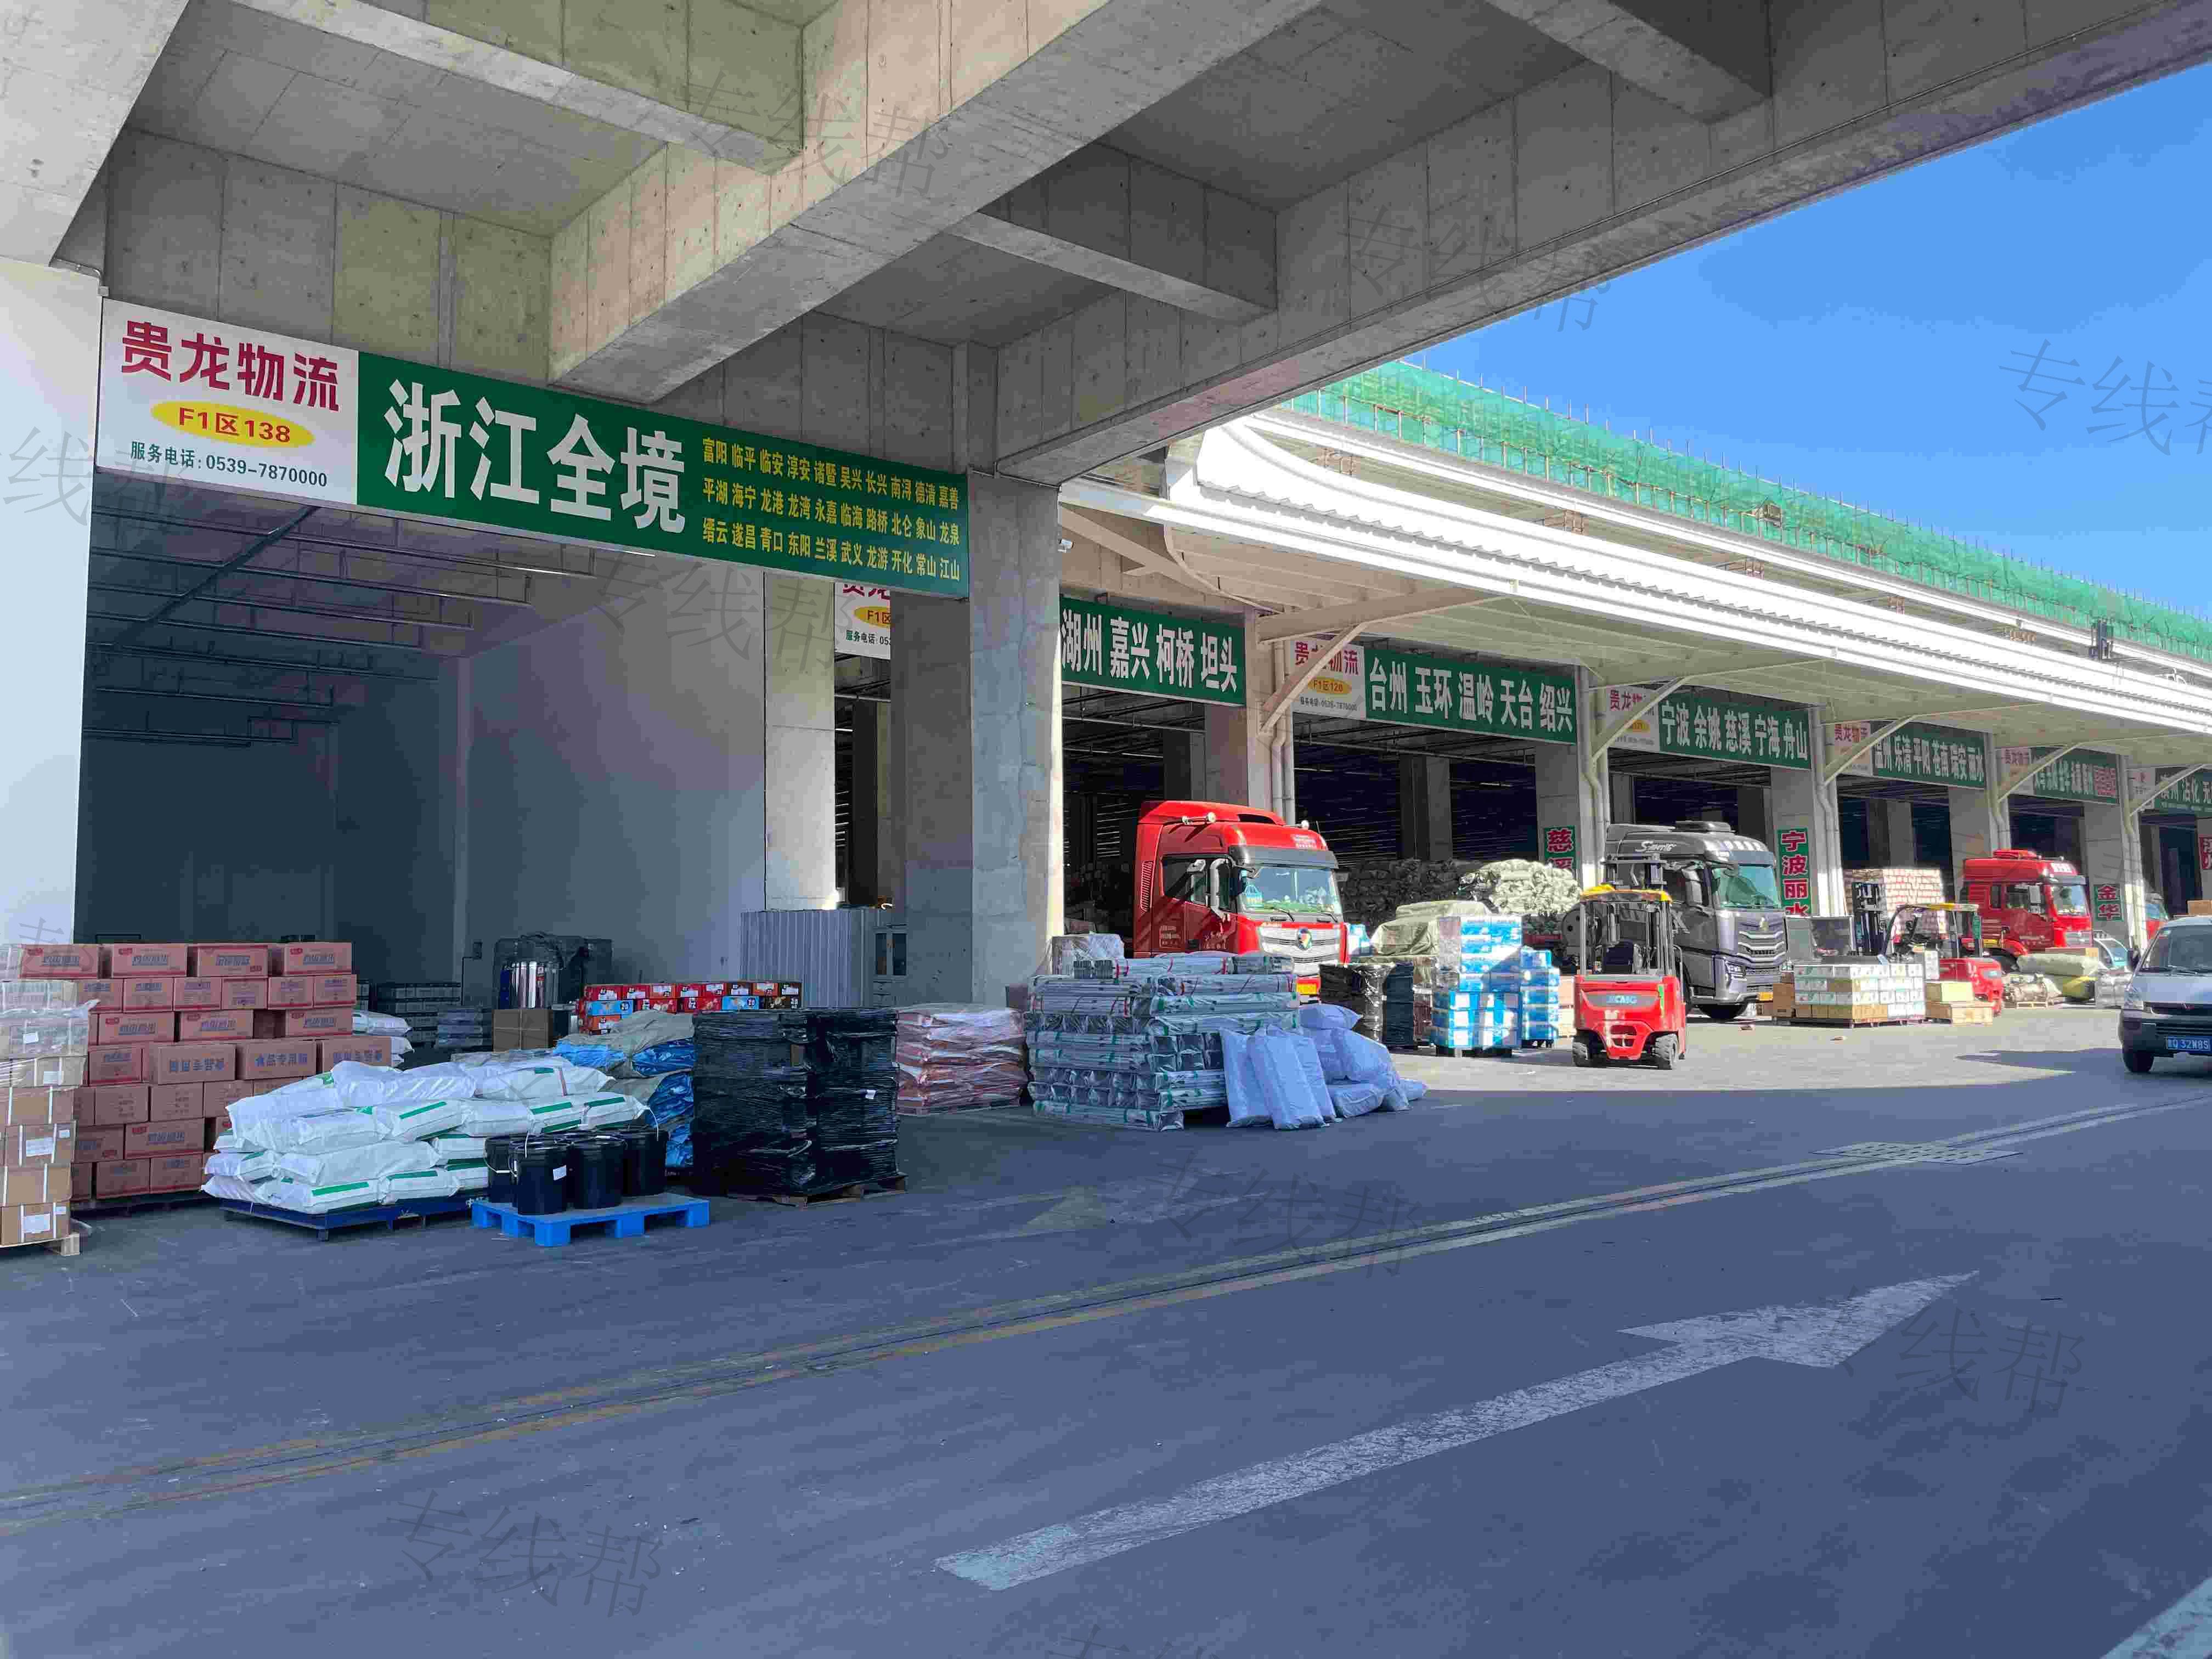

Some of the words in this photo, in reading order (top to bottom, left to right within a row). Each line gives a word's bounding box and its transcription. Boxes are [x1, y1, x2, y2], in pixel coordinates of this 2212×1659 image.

[121, 320, 339, 411] 贵龙物流
[179, 408, 291, 443] F1区138
[384, 379, 685, 533] 浙江全境
[131, 441, 327, 487] 服务电话:0539-7870000
[702, 438, 727, 465] 富阳
[732, 443, 755, 471] 临平
[760, 449, 783, 476] 临安
[788, 454, 810, 482] 淳安
[814, 460, 836, 487] 诸暨
[841, 466, 862, 492] 吴兴
[865, 472, 887, 496] 长兴
[891, 475, 912, 501] 南浔
[915, 481, 935, 506] 德清
[939, 486, 958, 510] 嘉善
[703, 478, 728, 505] 平湖
[732, 483, 755, 509] 海宁
[760, 488, 784, 515] 龙港
[788, 493, 811, 521] 龙湾
[815, 499, 837, 526] 永嘉
[841, 503, 862, 530] 临海
[867, 507, 888, 535] 路桥
[892, 512, 912, 538] 北仑
[916, 517, 935, 541] 象山
[940, 522, 960, 545] 龙泉
[732, 522, 755, 550] 遂昌
[760, 527, 783, 553] 青口
[788, 532, 811, 558] 东阳
[815, 536, 837, 562] 兰溪
[841, 541, 862, 567] 武义
[867, 546, 887, 571] 龙游
[892, 551, 912, 574] 开化
[916, 553, 936, 578] 常山
[940, 557, 960, 581] 江山
[1062, 608, 1102, 675] 湖州
[1110, 616, 1150, 680] 嘉兴
[1156, 624, 1194, 689] 柯桥
[1201, 633, 1237, 692] 坦头
[1370, 657, 1407, 713] 台州
[1415, 667, 1452, 720] 玉环
[1458, 672, 1494, 725] 温岭
[1500, 680, 1533, 729] 天台
[1540, 684, 1573, 733] 绍兴
[1662, 700, 1690, 746] 宁波
[1694, 706, 1721, 751] 余姚
[1724, 710, 1751, 755] 慈溪
[1756, 714, 1780, 758] 宁海
[1783, 719, 1807, 761] 舟山
[1781, 831, 1808, 916] 宁波丽水
[2097, 885, 2120, 921] 金华
